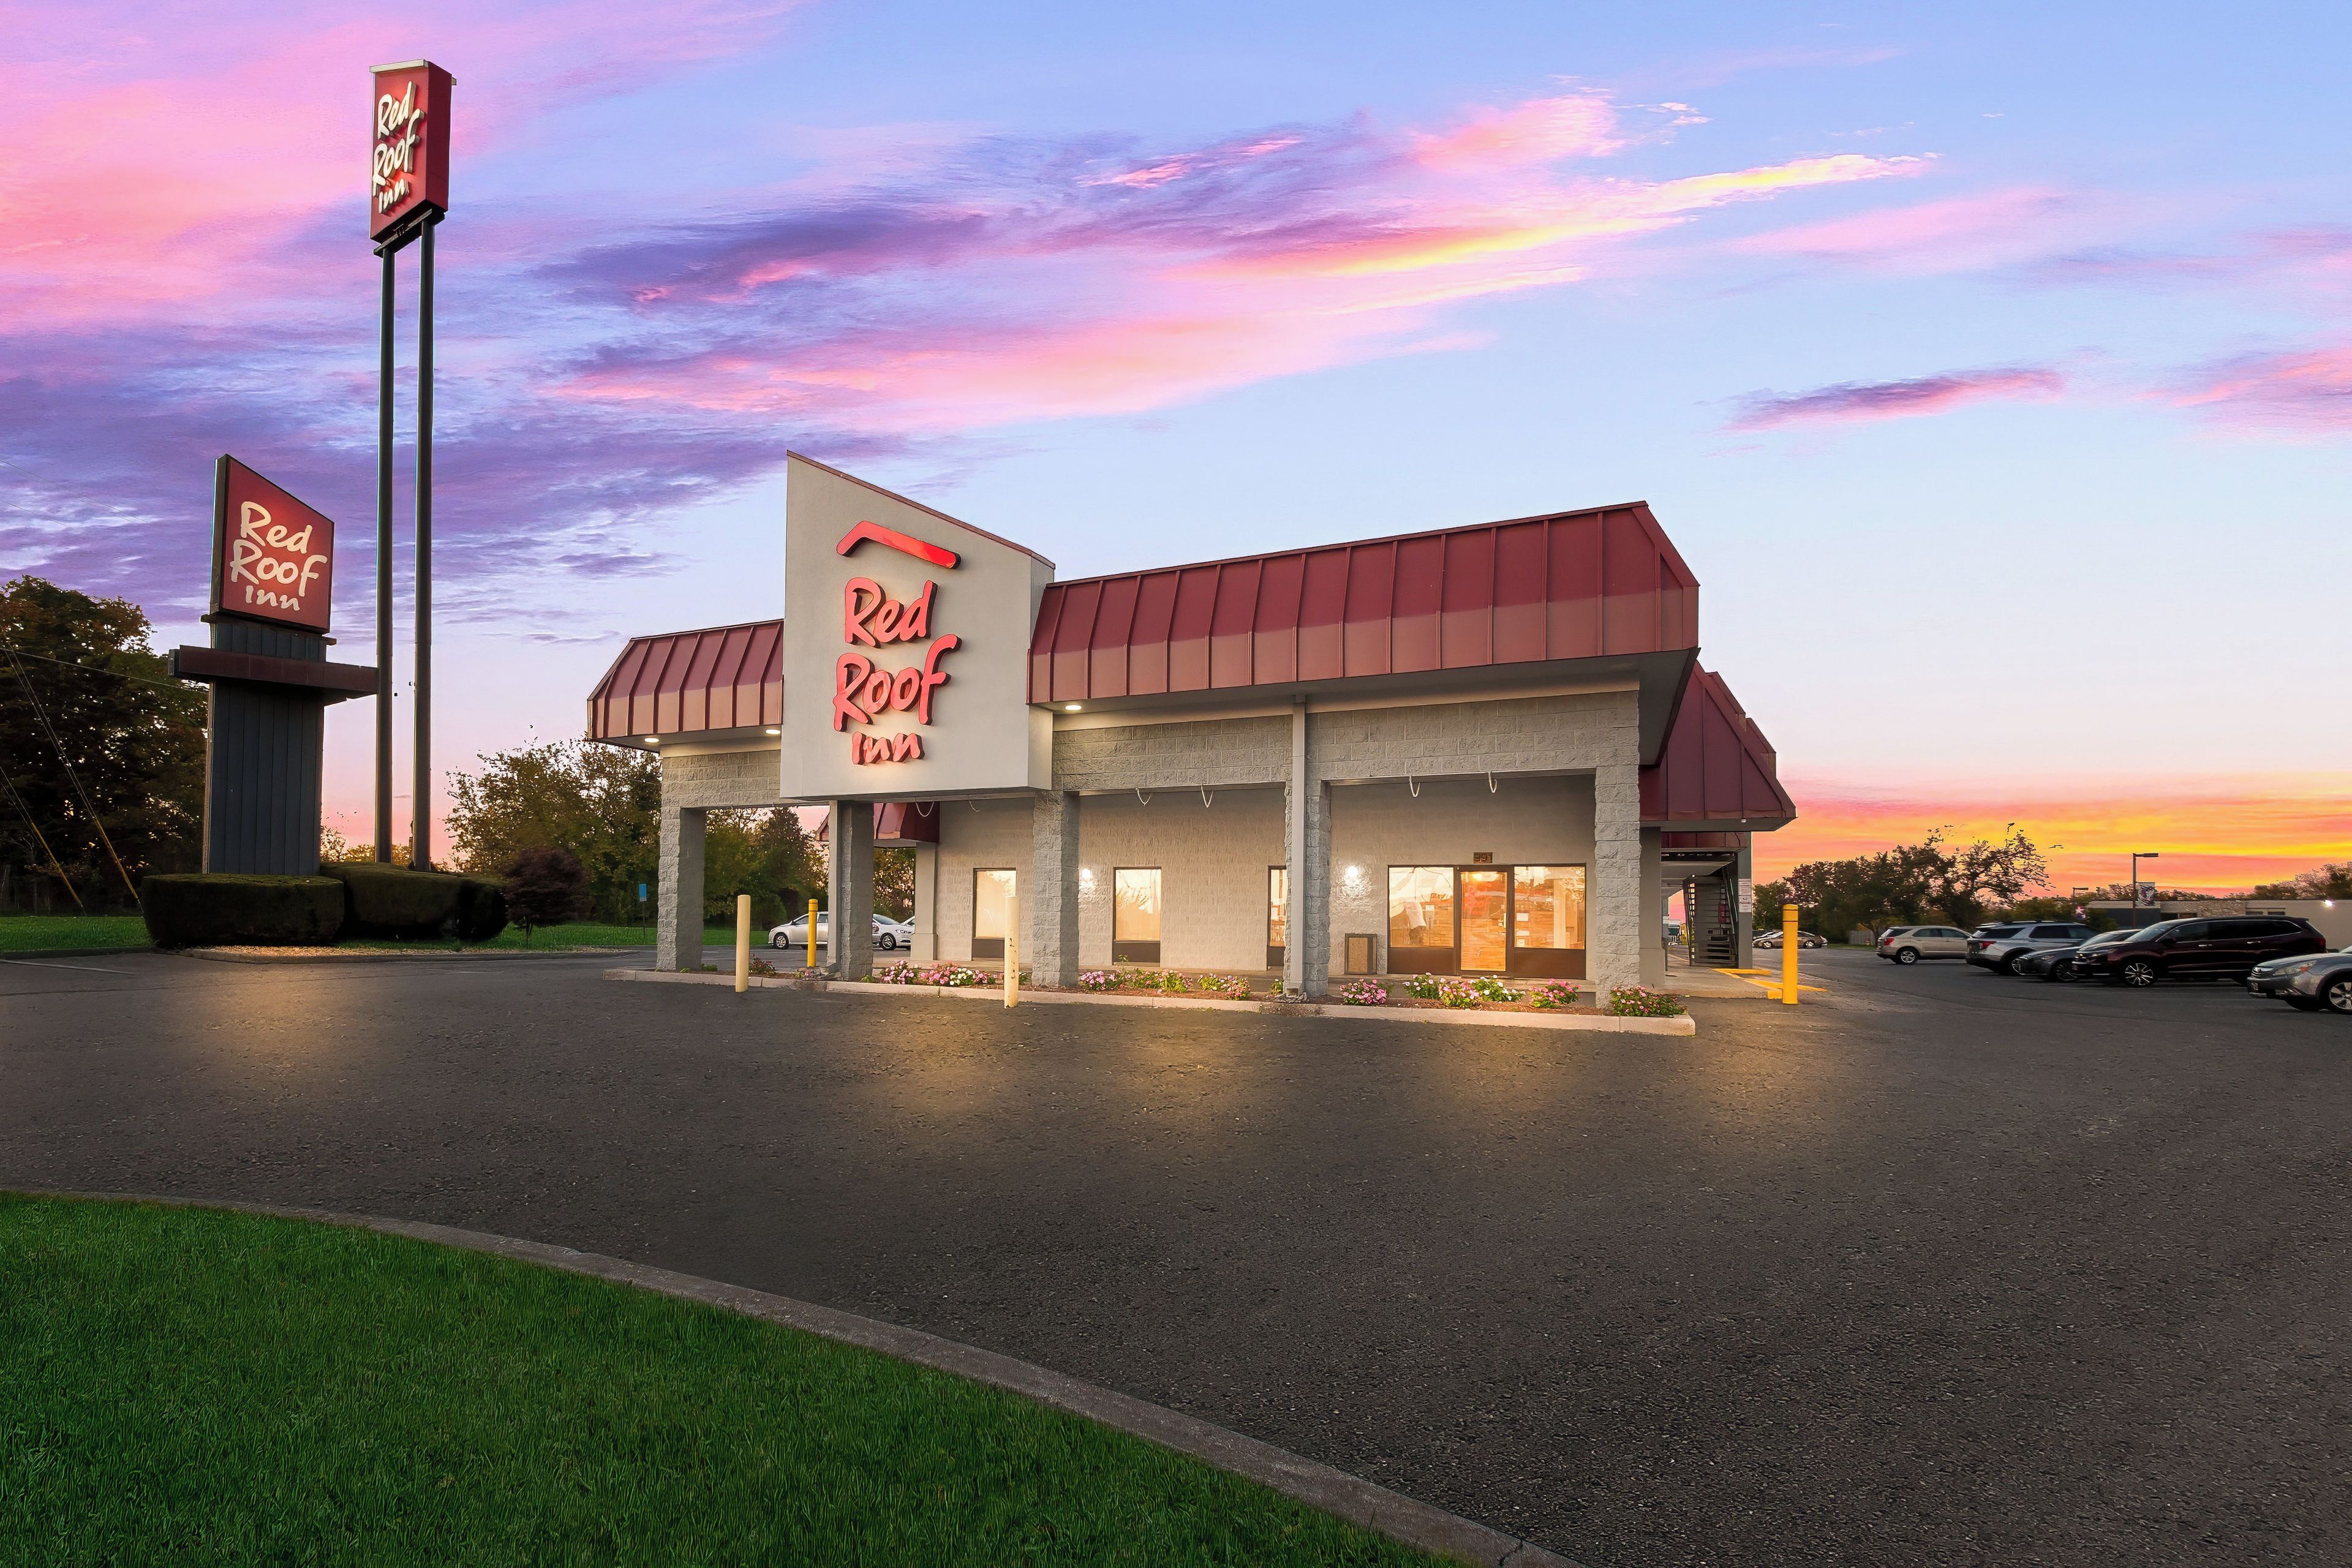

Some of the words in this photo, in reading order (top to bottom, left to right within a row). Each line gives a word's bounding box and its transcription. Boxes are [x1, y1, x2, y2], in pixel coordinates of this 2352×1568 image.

[378, 81, 415, 140] Red
[372, 108, 423, 197] Roof
[240, 501, 313, 554] Red
[230, 539, 328, 597] Roof
[246, 585, 300, 611] Inn
[844, 577, 937, 649] Red
[833, 634, 961, 732] Roof
[852, 731, 924, 765] Inn
